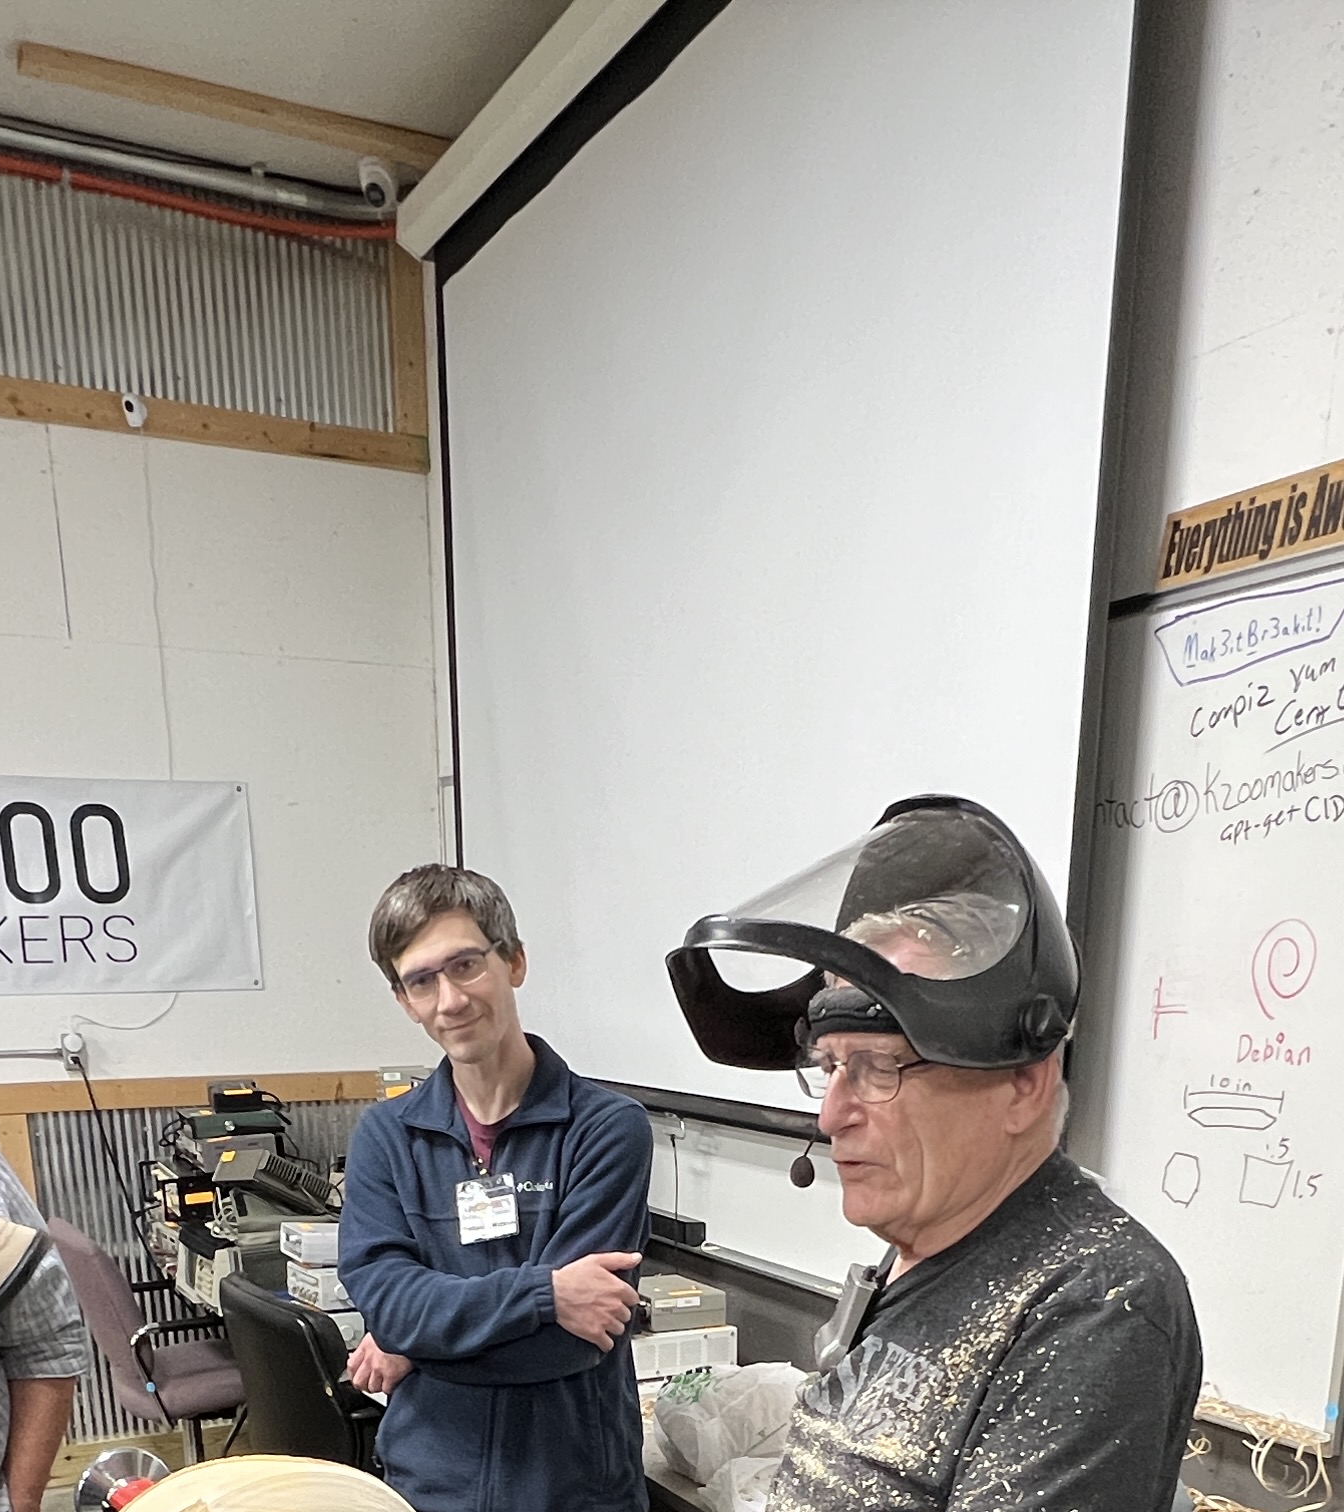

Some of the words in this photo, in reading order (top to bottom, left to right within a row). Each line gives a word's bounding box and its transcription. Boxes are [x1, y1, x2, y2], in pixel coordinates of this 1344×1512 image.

[1162, 496, 1283, 579] Everything
[1278, 483, 1307, 548] is
[1293, 1170, 1323, 1199] 1.5
